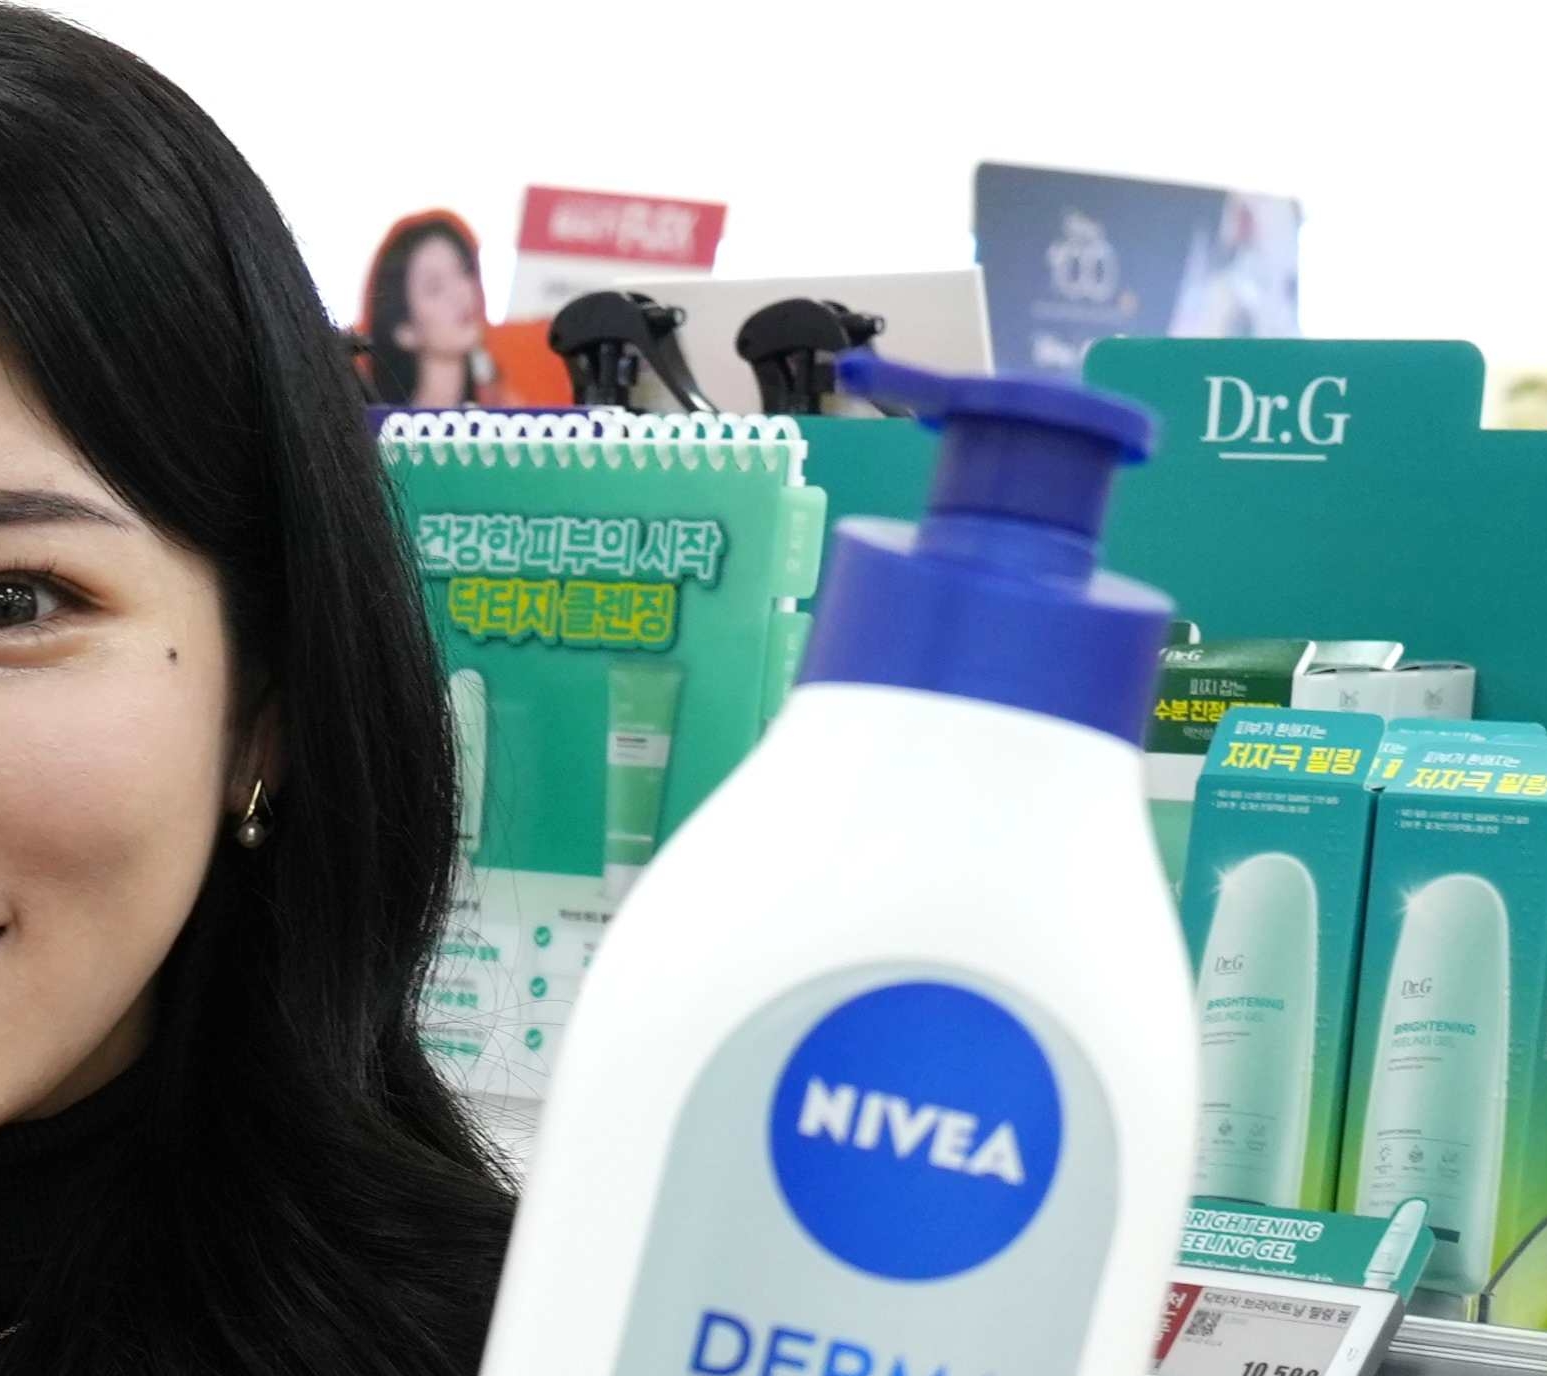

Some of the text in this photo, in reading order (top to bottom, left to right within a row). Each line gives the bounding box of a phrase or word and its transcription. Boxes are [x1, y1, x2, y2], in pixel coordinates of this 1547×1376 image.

[1201, 373, 1351, 448] Dr.G
[417, 515, 722, 581] 건강한 피부의 시작
[449, 581, 679, 644] 닥터지 클렌징
[1222, 742, 1362, 775] 저자극 필링
[1407, 768, 1490, 792] 저자극
[796, 1075, 1026, 1188] NIVEA
[1256, 1240, 1299, 1263] GEL
